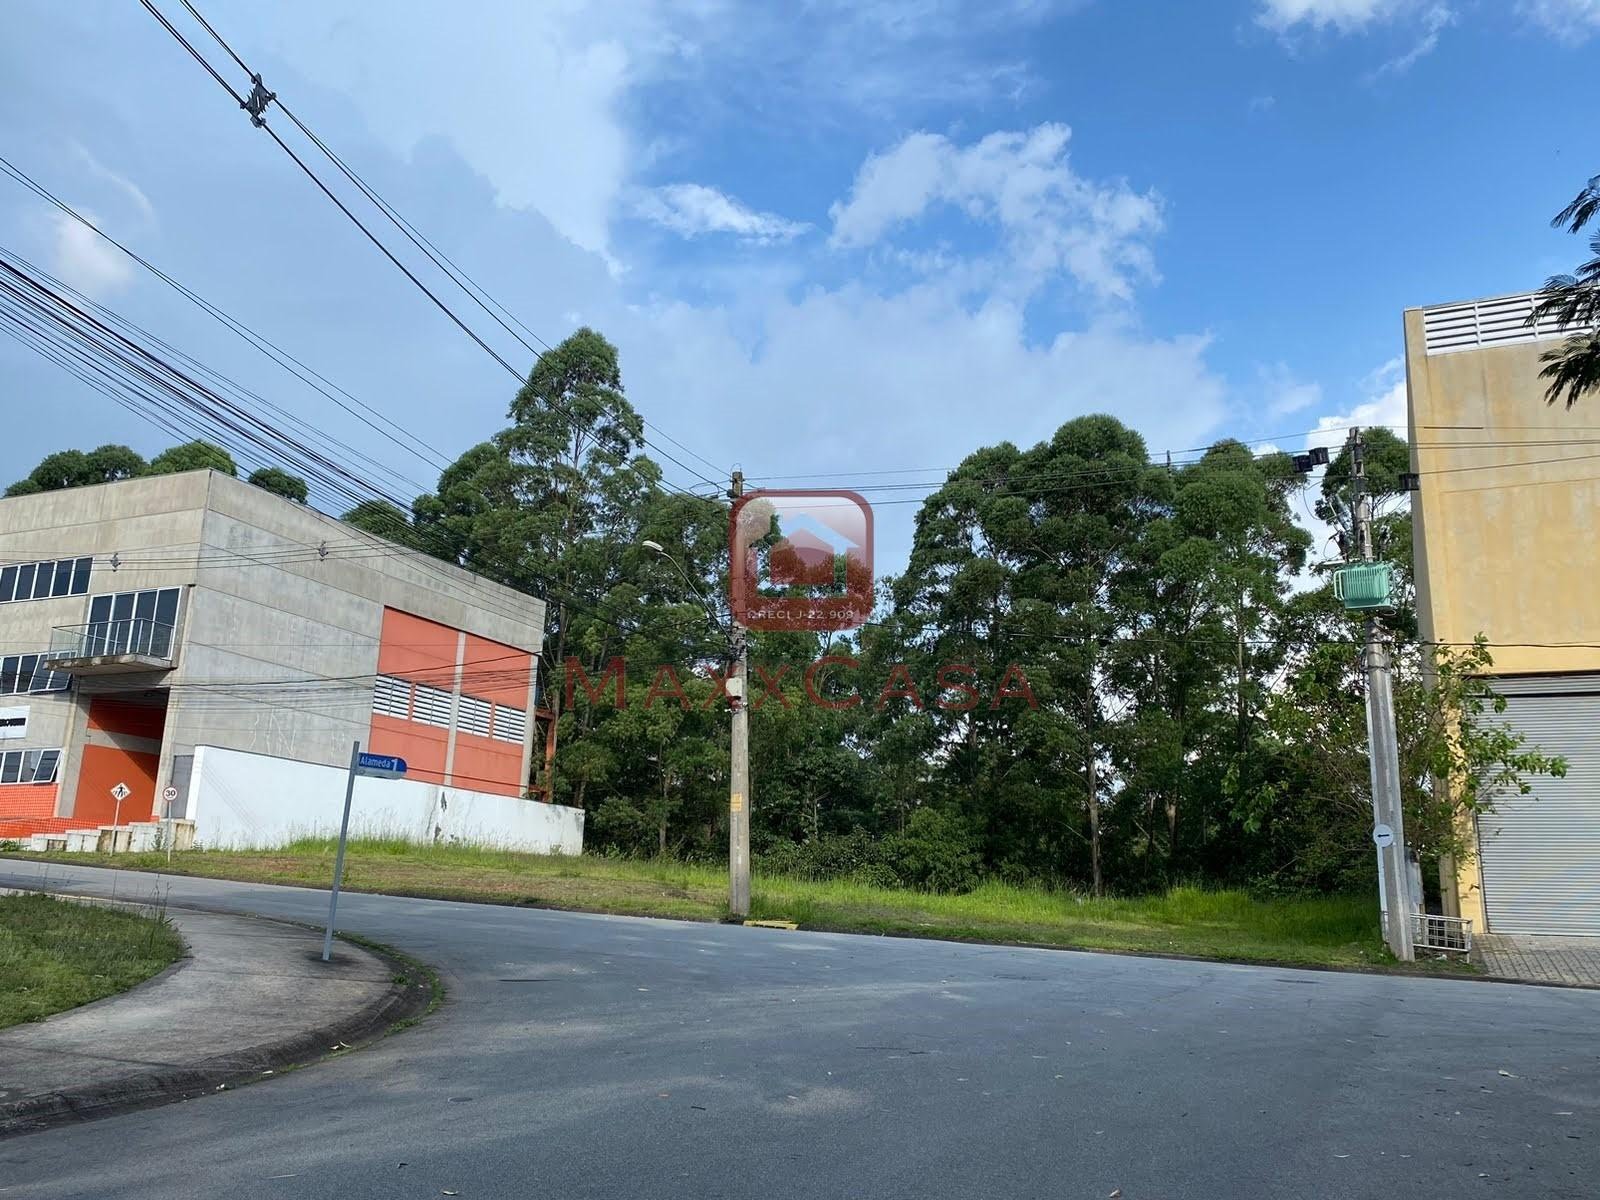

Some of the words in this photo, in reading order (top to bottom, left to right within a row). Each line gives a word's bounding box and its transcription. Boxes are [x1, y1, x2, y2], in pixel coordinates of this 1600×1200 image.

[360, 756, 391, 768] Alameda
[391, 758, 399, 772] 1
[165, 789, 176, 797] 30
